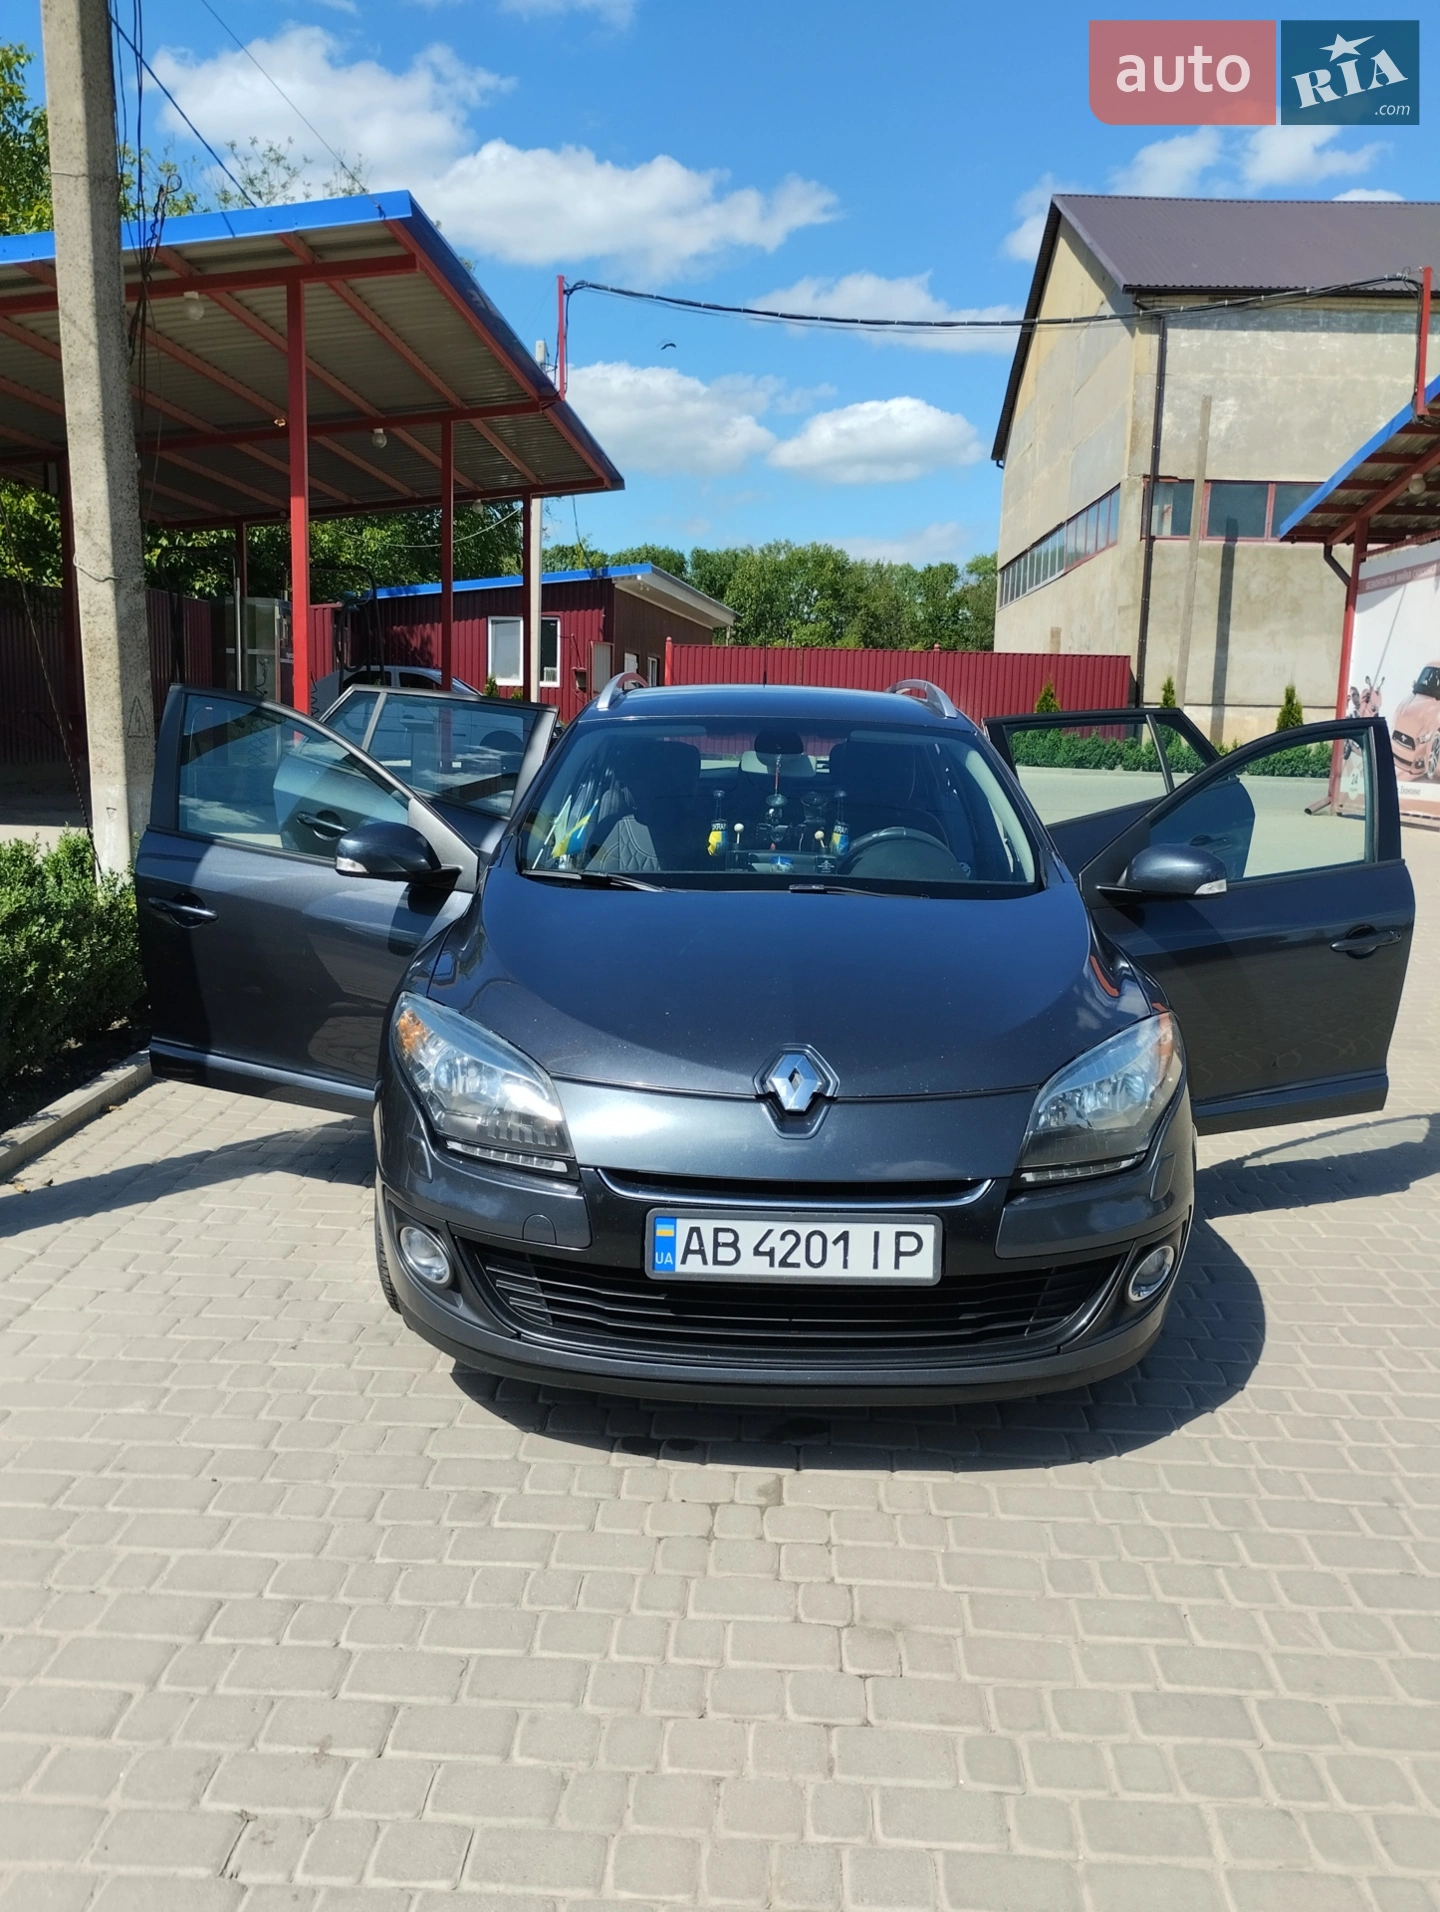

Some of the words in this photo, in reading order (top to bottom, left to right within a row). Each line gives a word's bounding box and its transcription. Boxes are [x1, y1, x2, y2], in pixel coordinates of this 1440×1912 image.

[655, 1251, 674, 1265] UA
[680, 1226, 742, 1266] AB
[753, 1229, 850, 1269] 4201
[872, 1230, 924, 1270] IP
